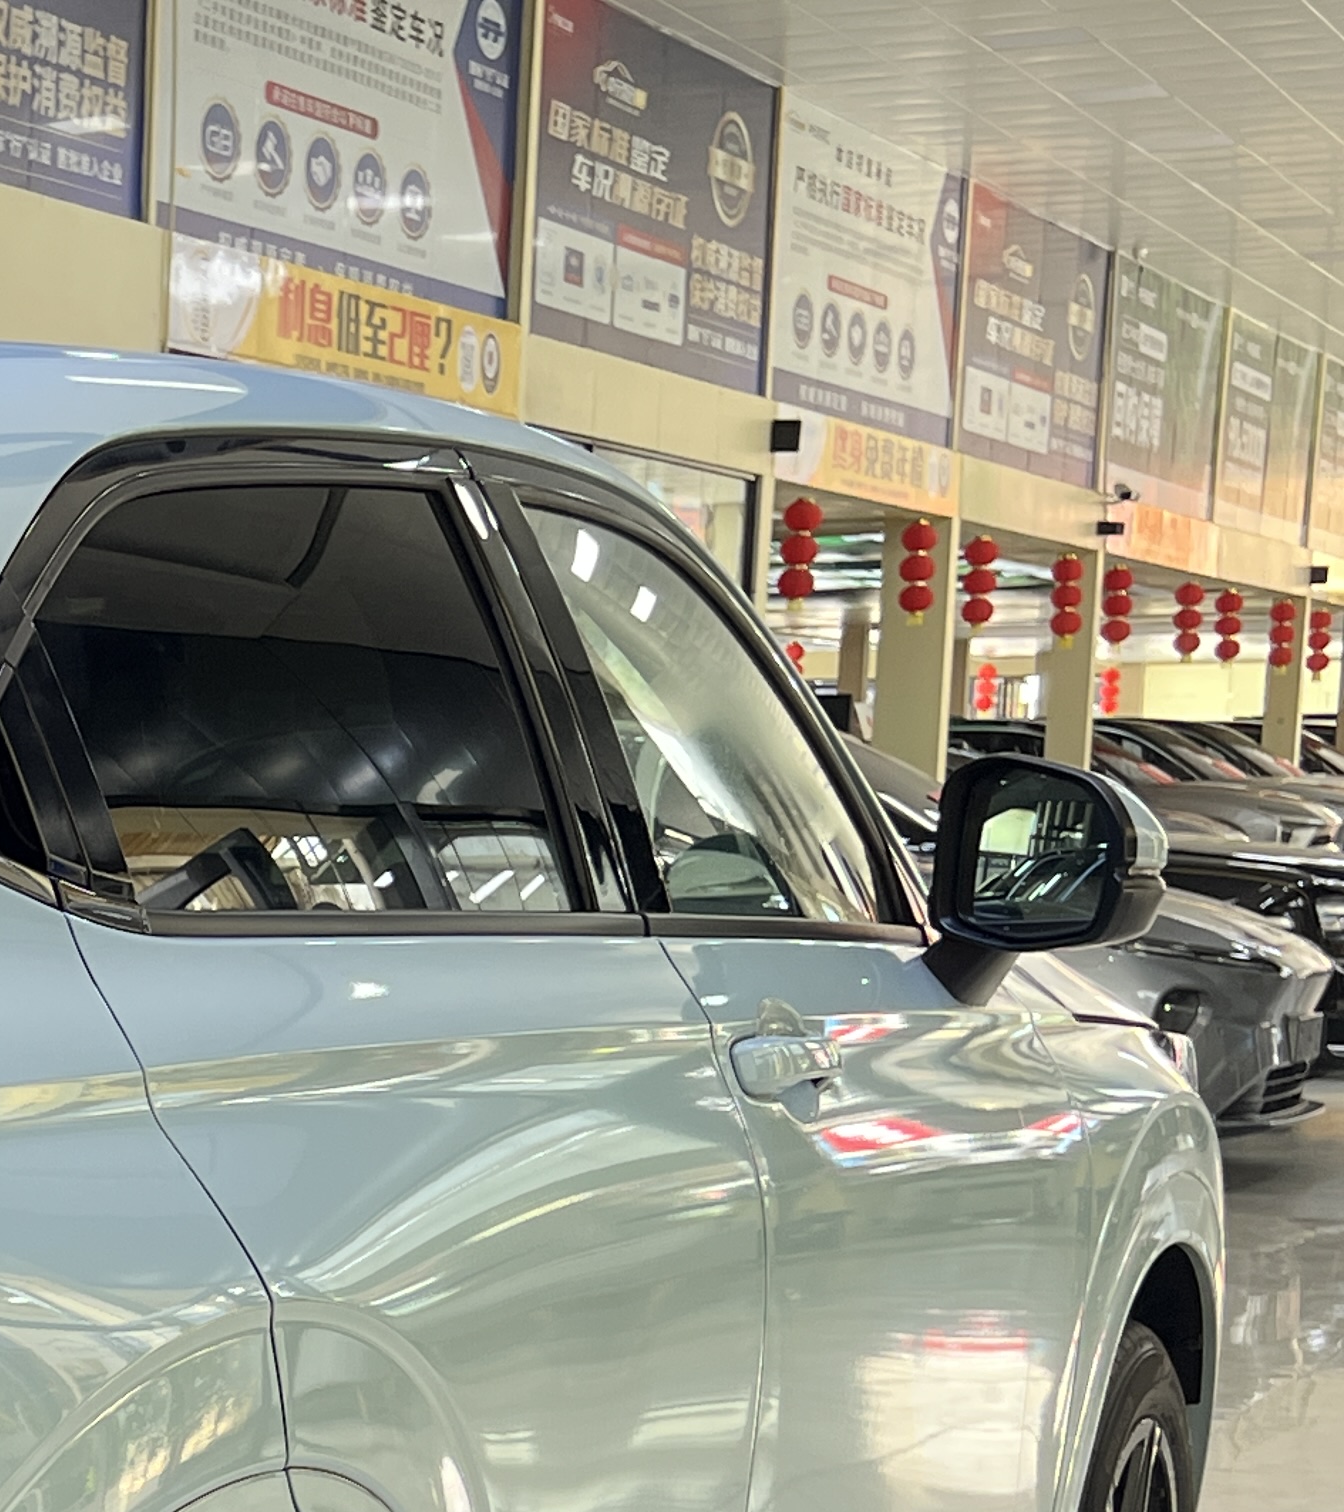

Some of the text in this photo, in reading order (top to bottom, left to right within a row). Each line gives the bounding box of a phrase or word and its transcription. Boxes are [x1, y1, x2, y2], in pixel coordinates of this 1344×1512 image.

[547, 99, 671, 182] 国家标准鉴定
